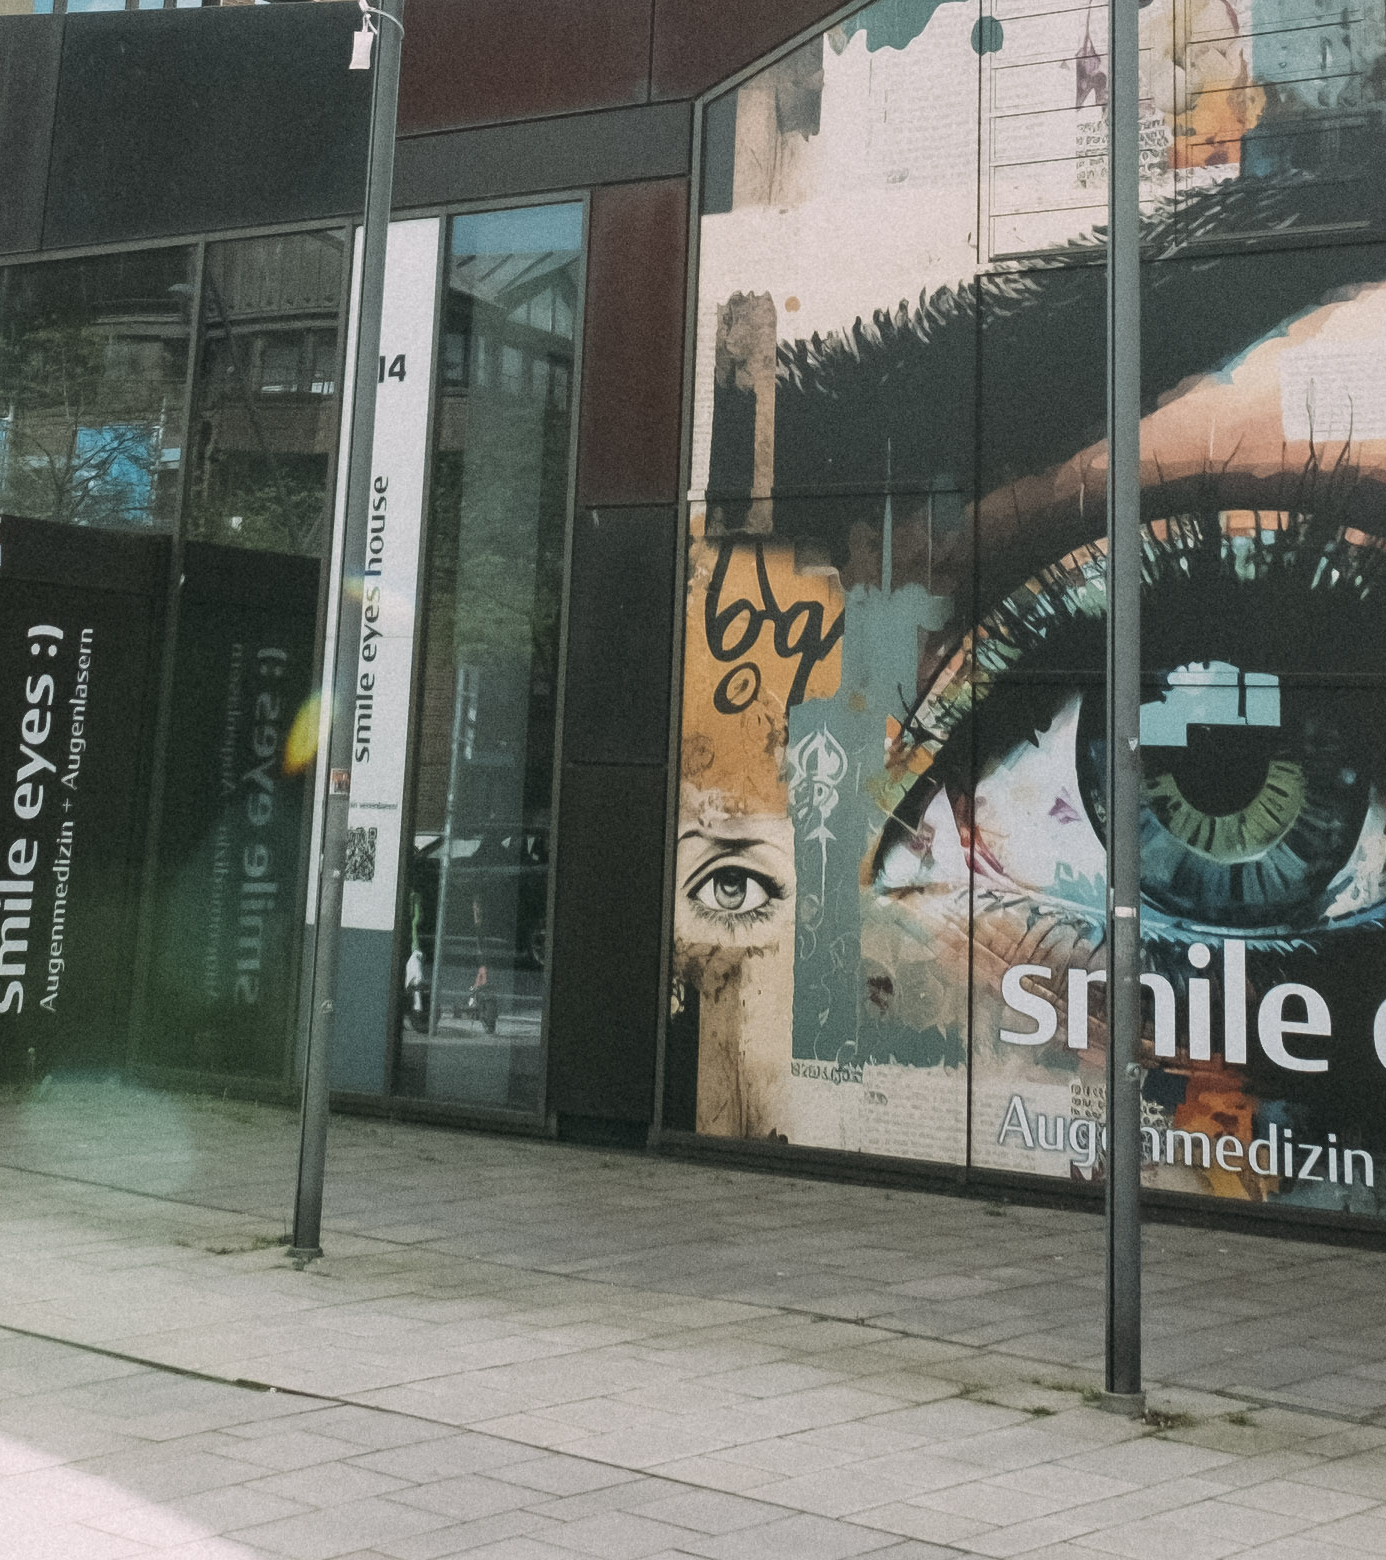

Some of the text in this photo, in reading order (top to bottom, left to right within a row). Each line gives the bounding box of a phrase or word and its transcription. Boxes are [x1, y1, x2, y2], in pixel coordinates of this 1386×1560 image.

[355, 476, 388, 763] smile eyes house
[14, 674, 56, 820] eyes
[40, 821, 74, 1012] Augenmedizin
[61, 628, 93, 790] Augenlasern
[999, 939, 1332, 1072] smile
[997, 1094, 1374, 1188] Augnmedizin
